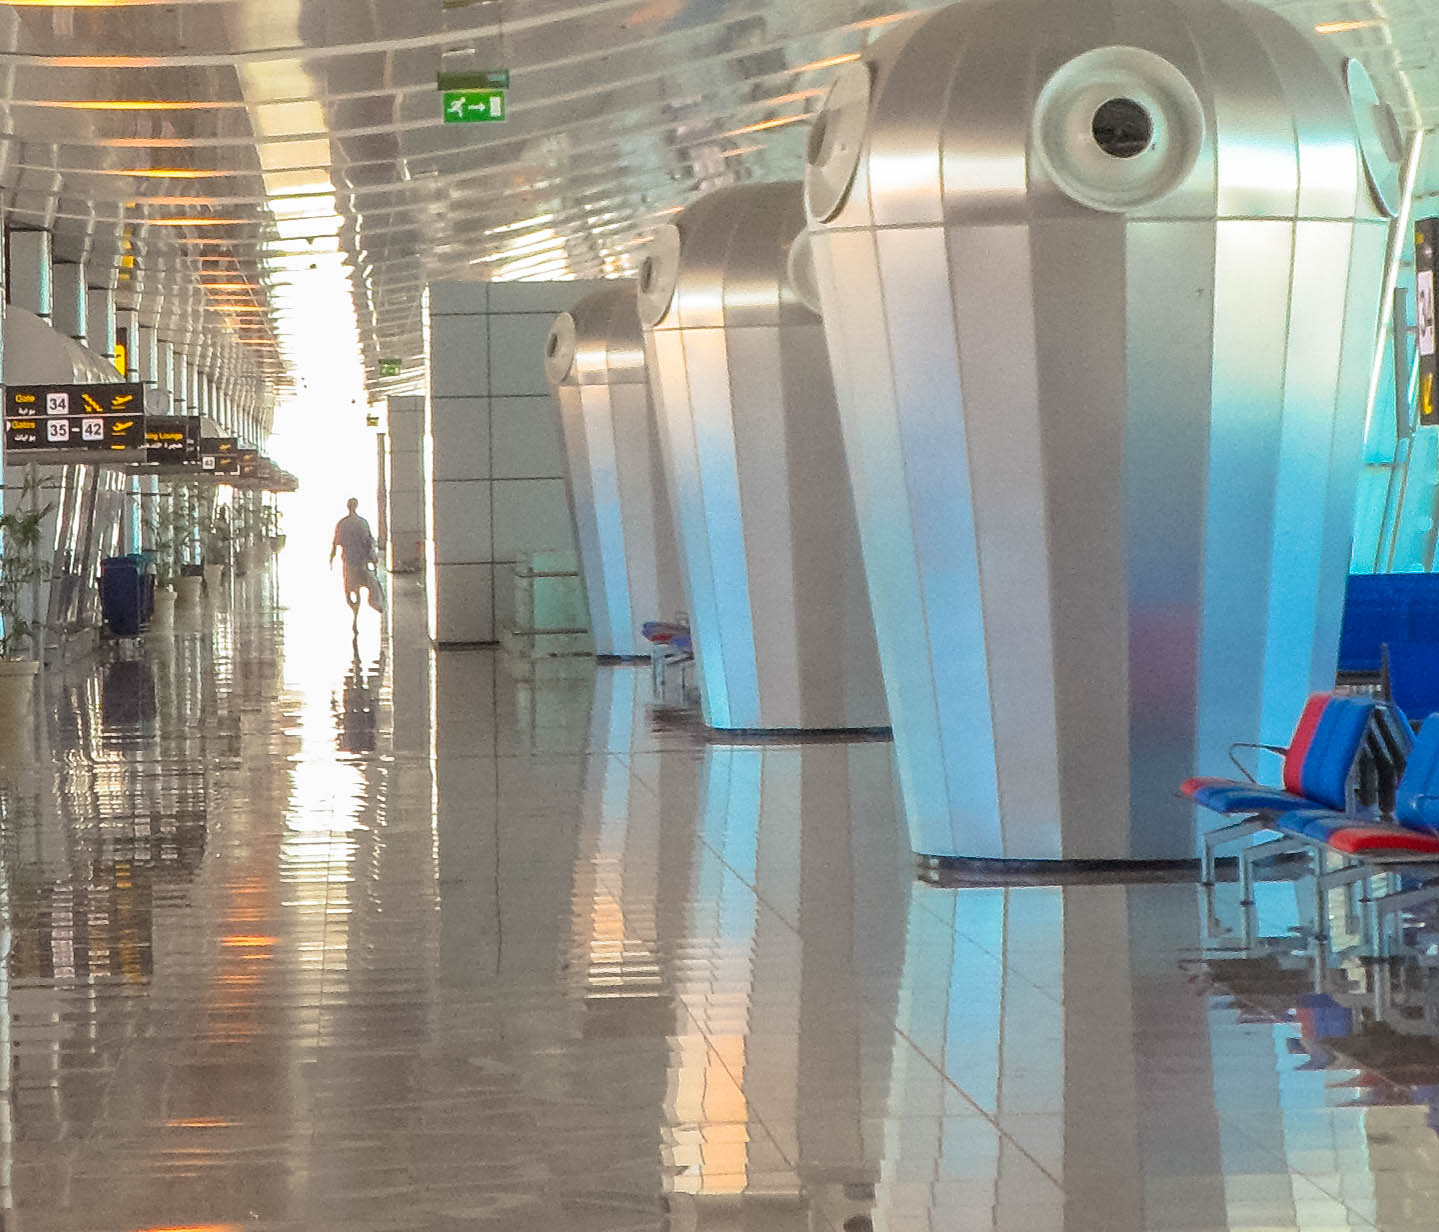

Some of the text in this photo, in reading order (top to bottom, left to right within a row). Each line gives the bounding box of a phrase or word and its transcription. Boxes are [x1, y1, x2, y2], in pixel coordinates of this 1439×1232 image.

[49, 398, 66, 410] 34
[50, 424, 67, 436] 35
[84, 423, 102, 436] 42
